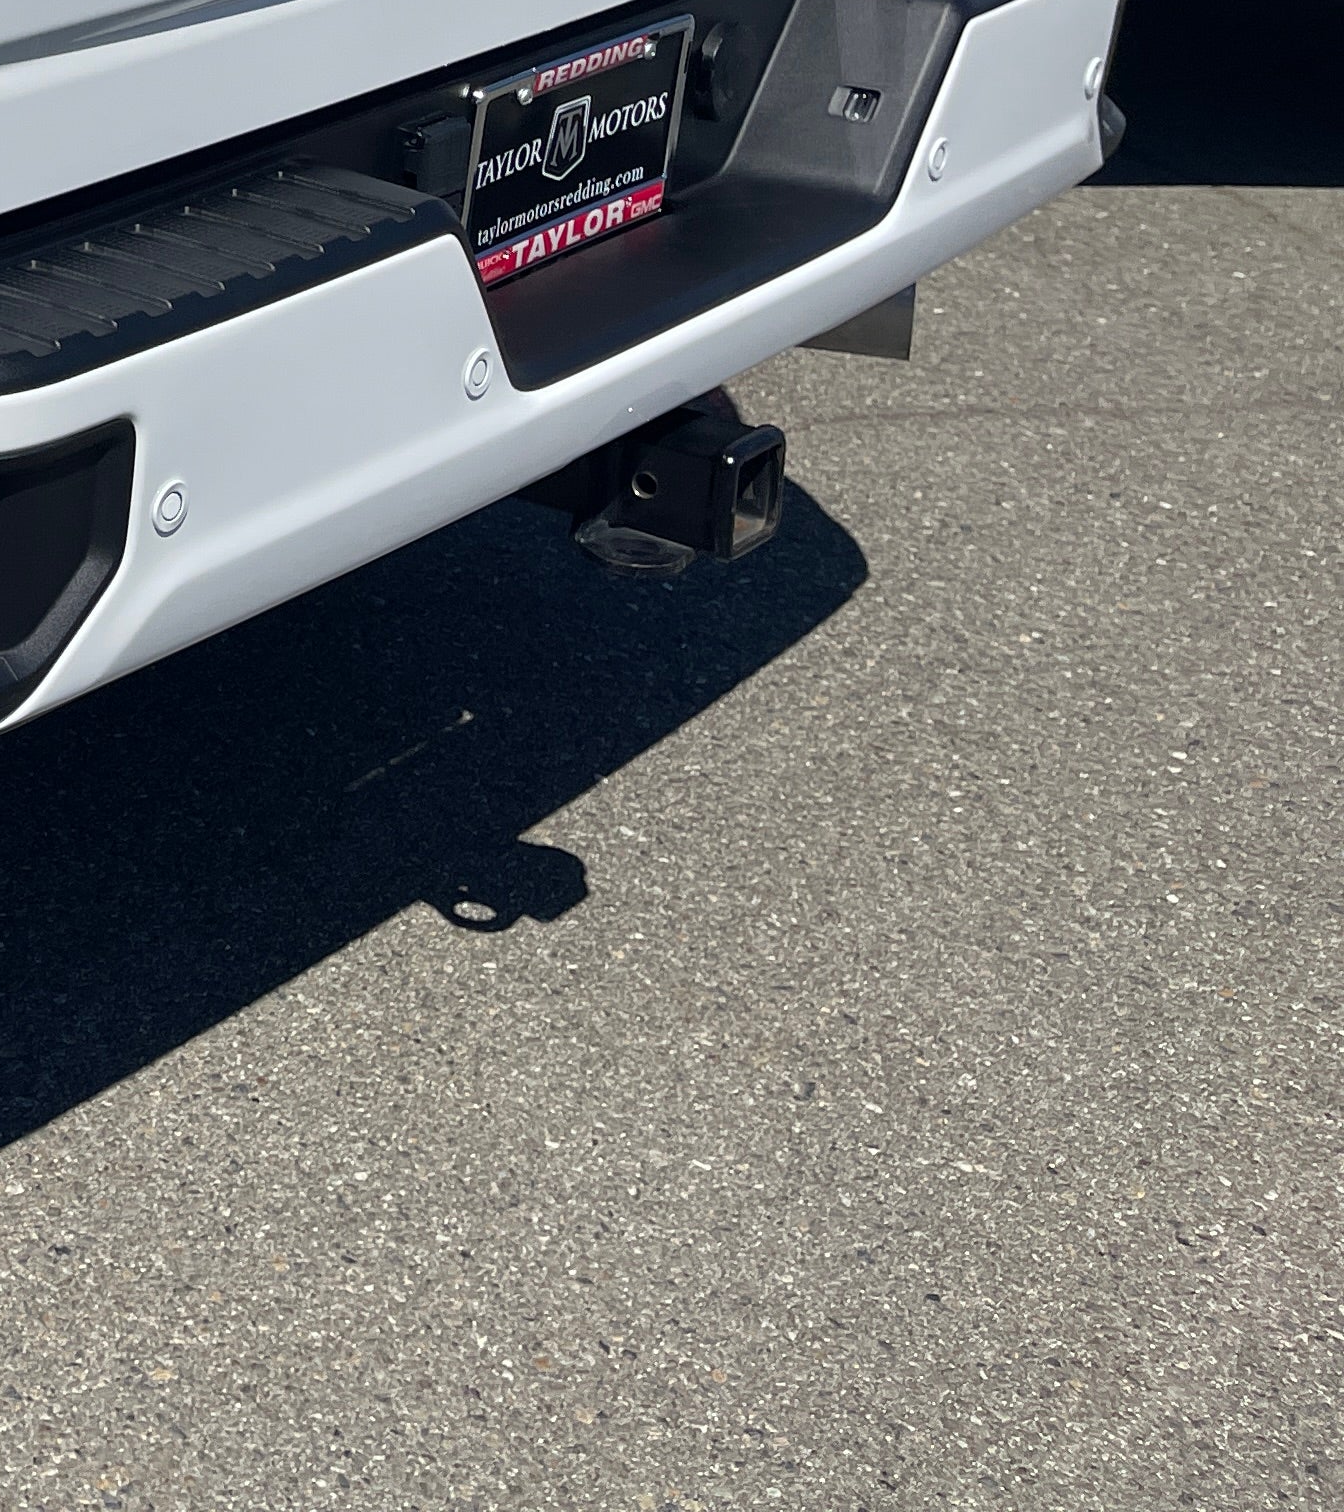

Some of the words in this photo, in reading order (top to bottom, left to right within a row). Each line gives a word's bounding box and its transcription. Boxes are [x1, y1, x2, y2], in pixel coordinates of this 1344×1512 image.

[537, 37, 645, 91] REDDING
[475, 138, 542, 191] TAYLOR
[587, 92, 668, 143] MOTORS
[477, 163, 644, 247] taylormotorsredding.com
[512, 199, 625, 270] TAYLOR
[630, 194, 662, 218] GMC
